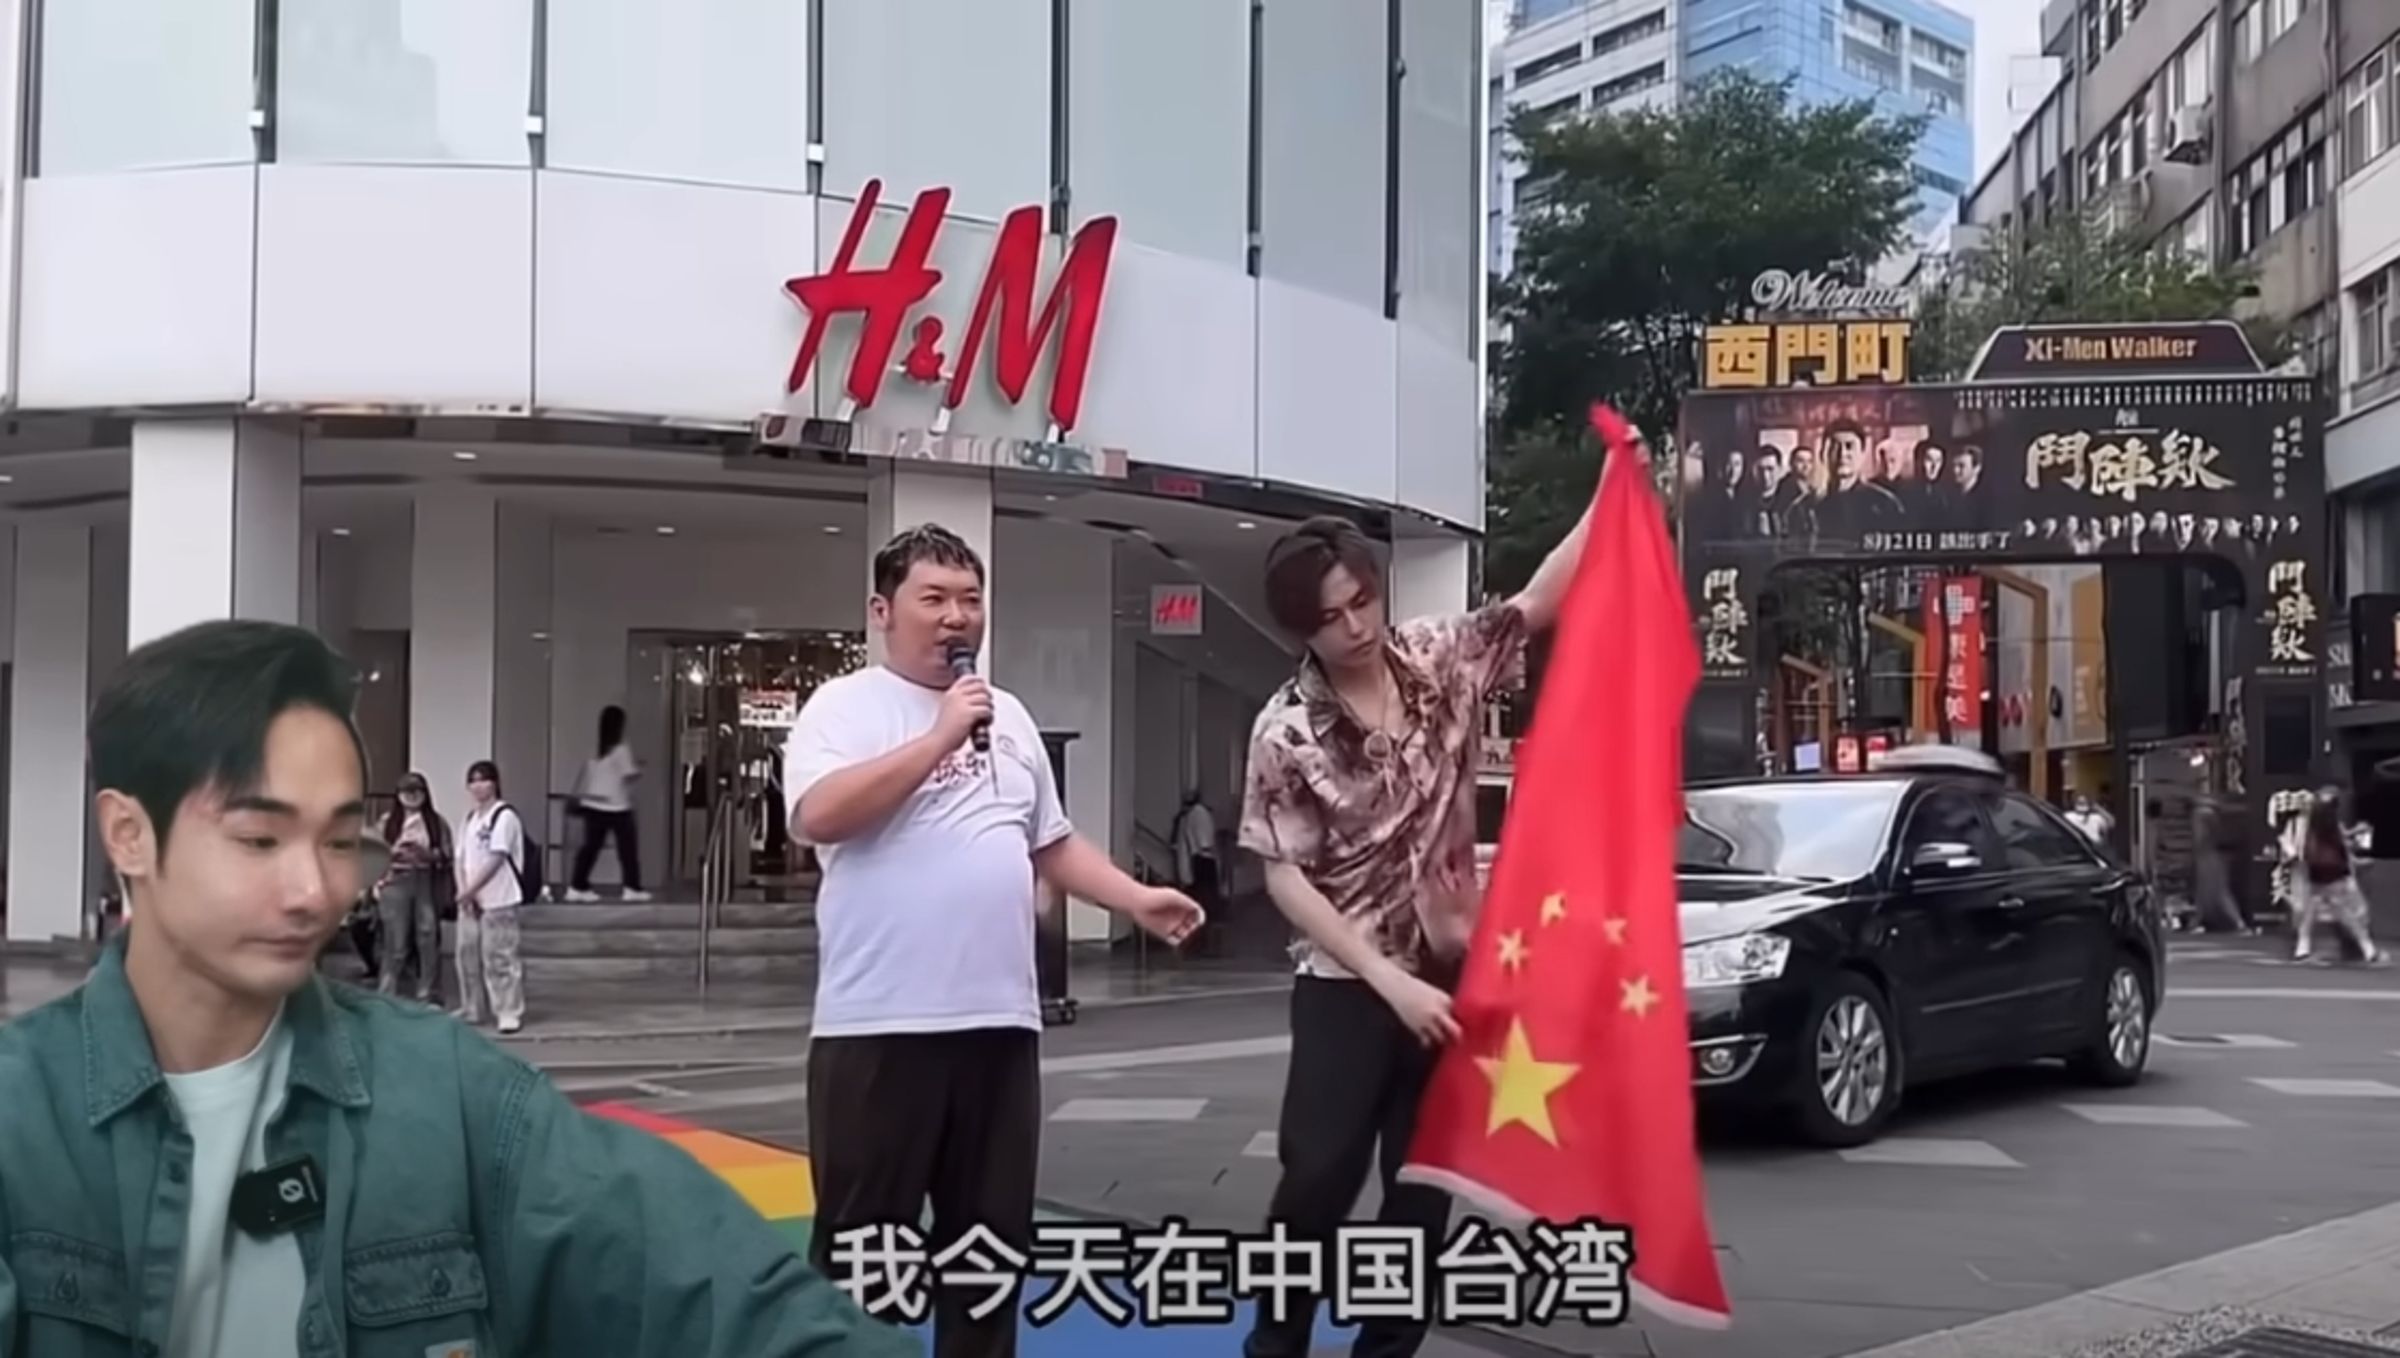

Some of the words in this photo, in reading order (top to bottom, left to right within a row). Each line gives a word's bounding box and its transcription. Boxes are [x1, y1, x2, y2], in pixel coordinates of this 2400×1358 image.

[784, 177, 1118, 432] H&M
[1706, 322, 1911, 387] 西門町
[2024, 335, 2107, 362] Xi-Men
[2110, 335, 2197, 360] Walker
